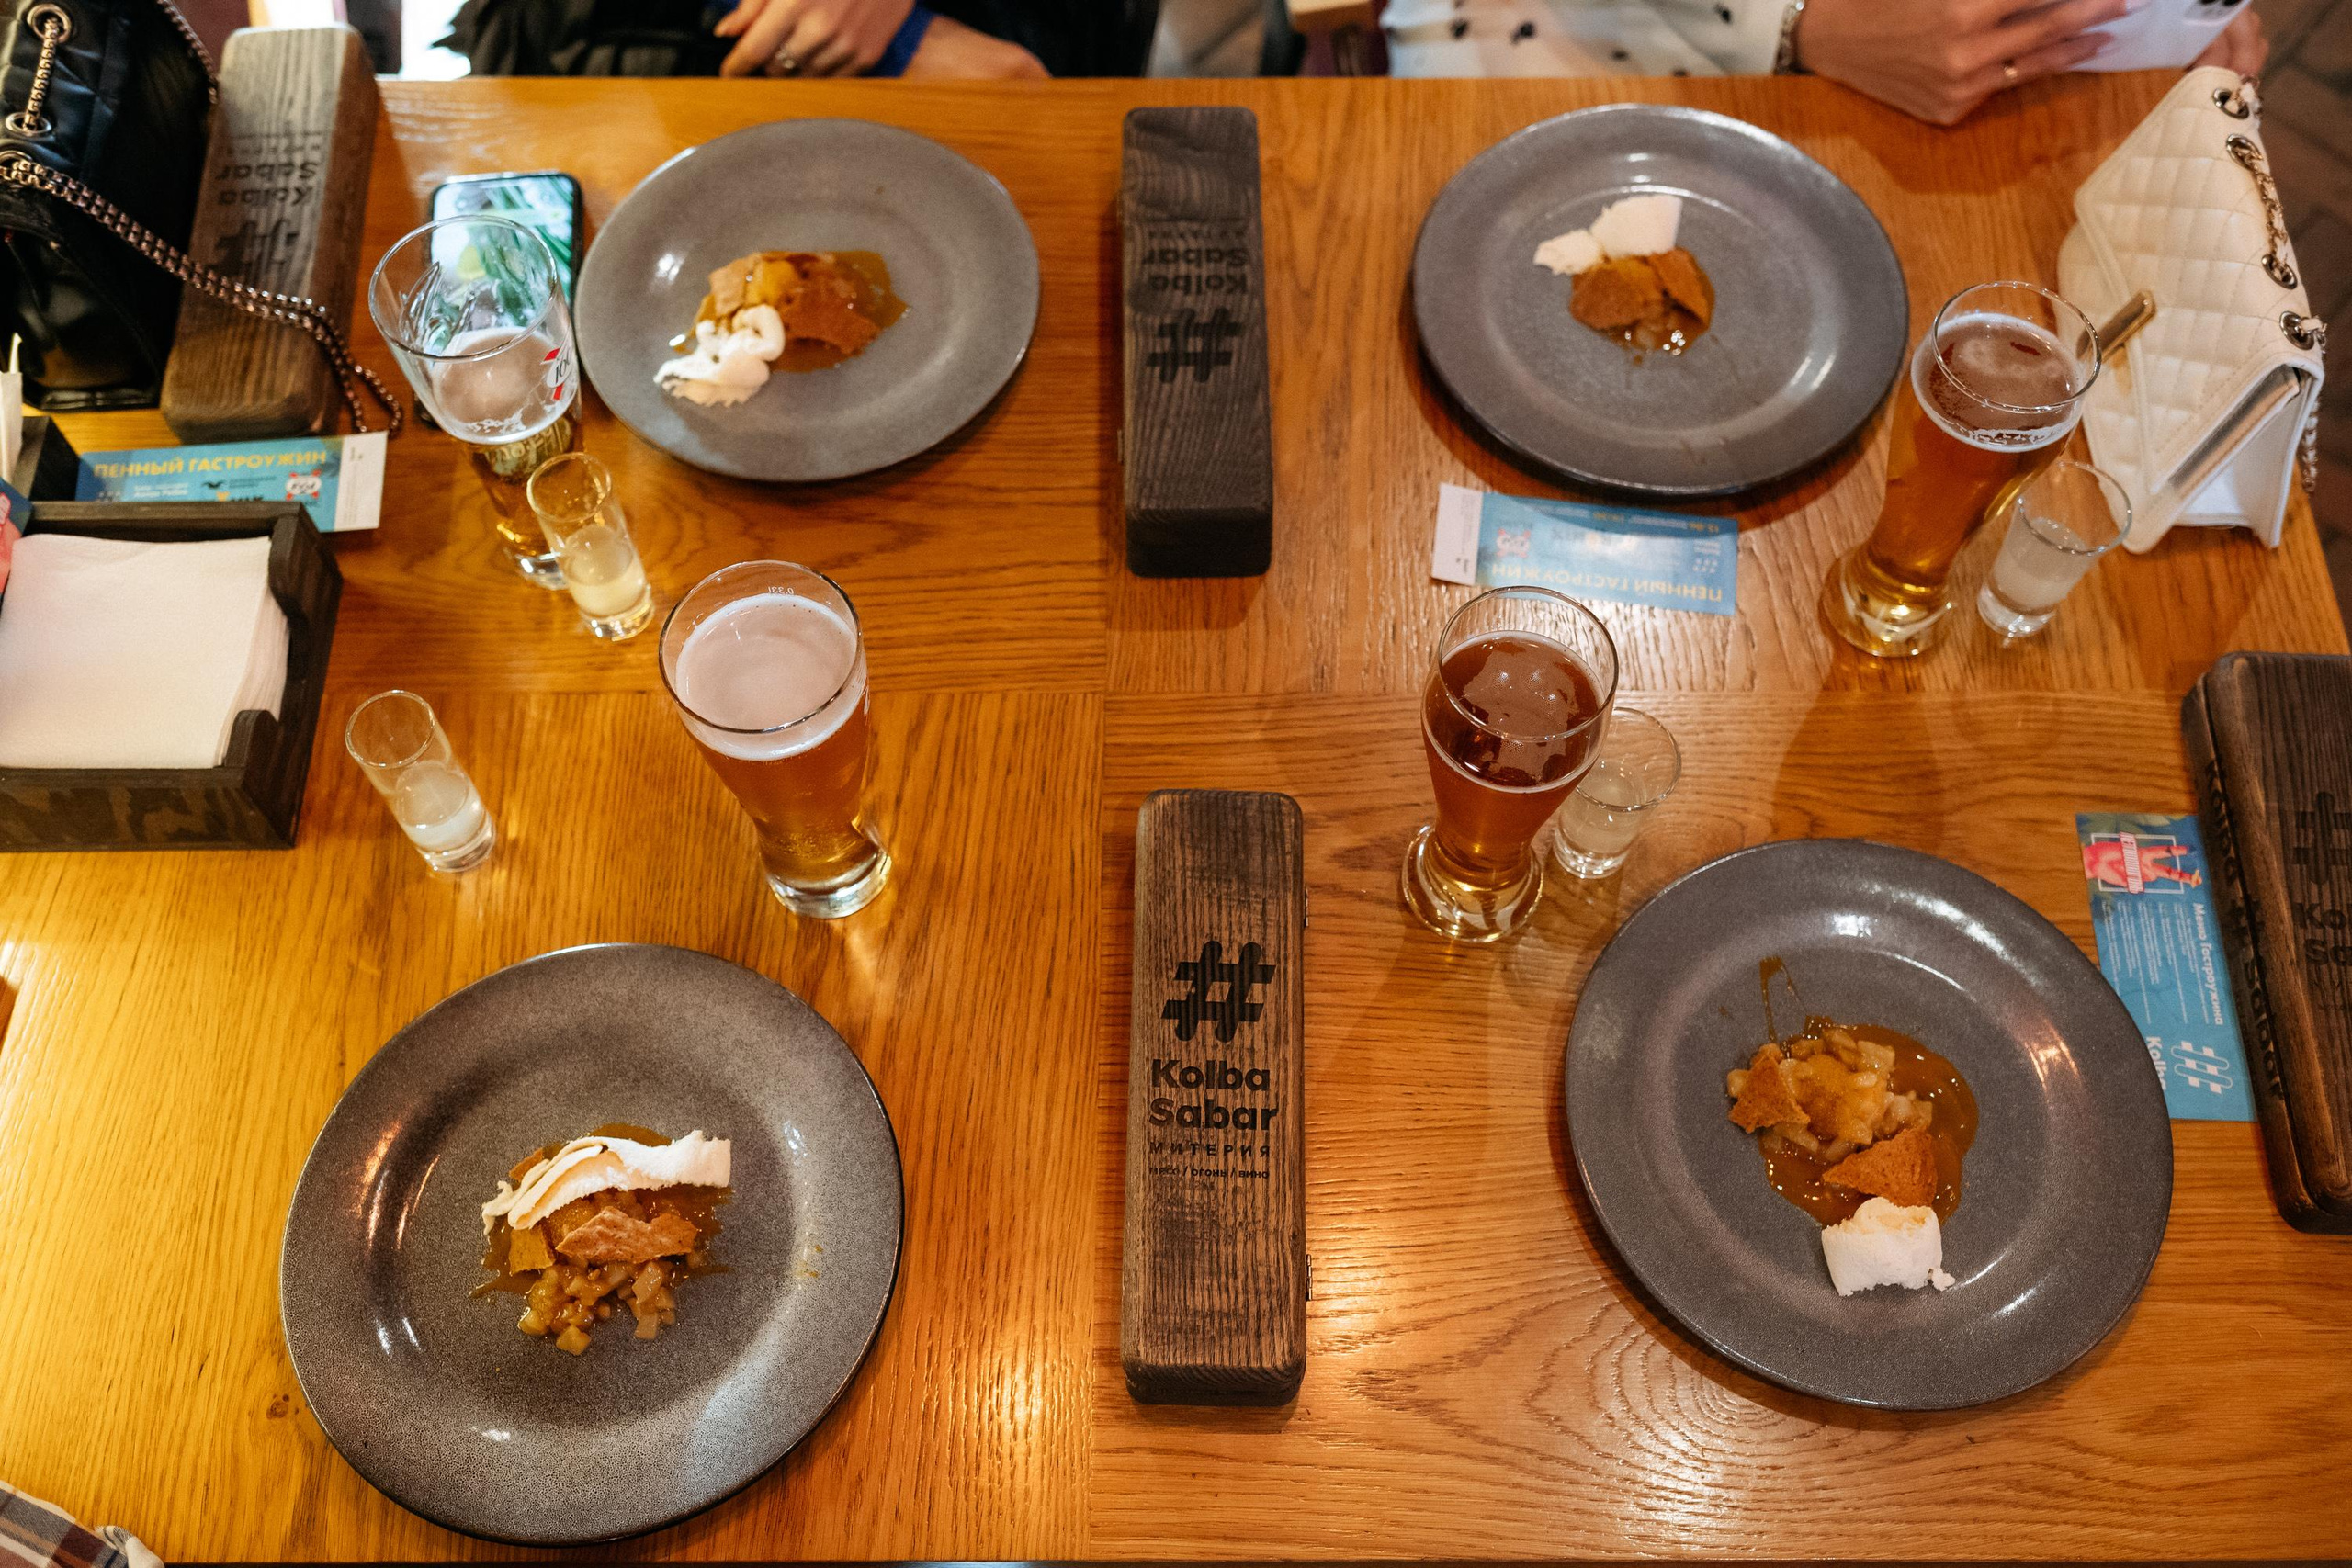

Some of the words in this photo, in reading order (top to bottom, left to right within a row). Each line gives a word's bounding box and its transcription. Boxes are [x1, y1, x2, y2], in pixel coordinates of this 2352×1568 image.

[1141, 248, 1249, 268] Sabar
[1148, 274, 1249, 296] Kolba
[94, 457, 183, 478] ПЕННЫЙ
[189, 450, 328, 472] ГАСТРОУЖИН
[1491, 564, 1630, 591] ГАСТРОУЖИН
[1634, 579, 1724, 602] ПЕННЫЙ
[2192, 902, 2208, 941] Меню
[1151, 1058, 1271, 1091] Kolba
[1148, 1097, 1279, 1130] Sabar
[1149, 1141, 1271, 1157] МИТЕРИЯ
[1191, 1168, 1227, 1178] огонь
[1238, 1169, 1270, 1179] вино
